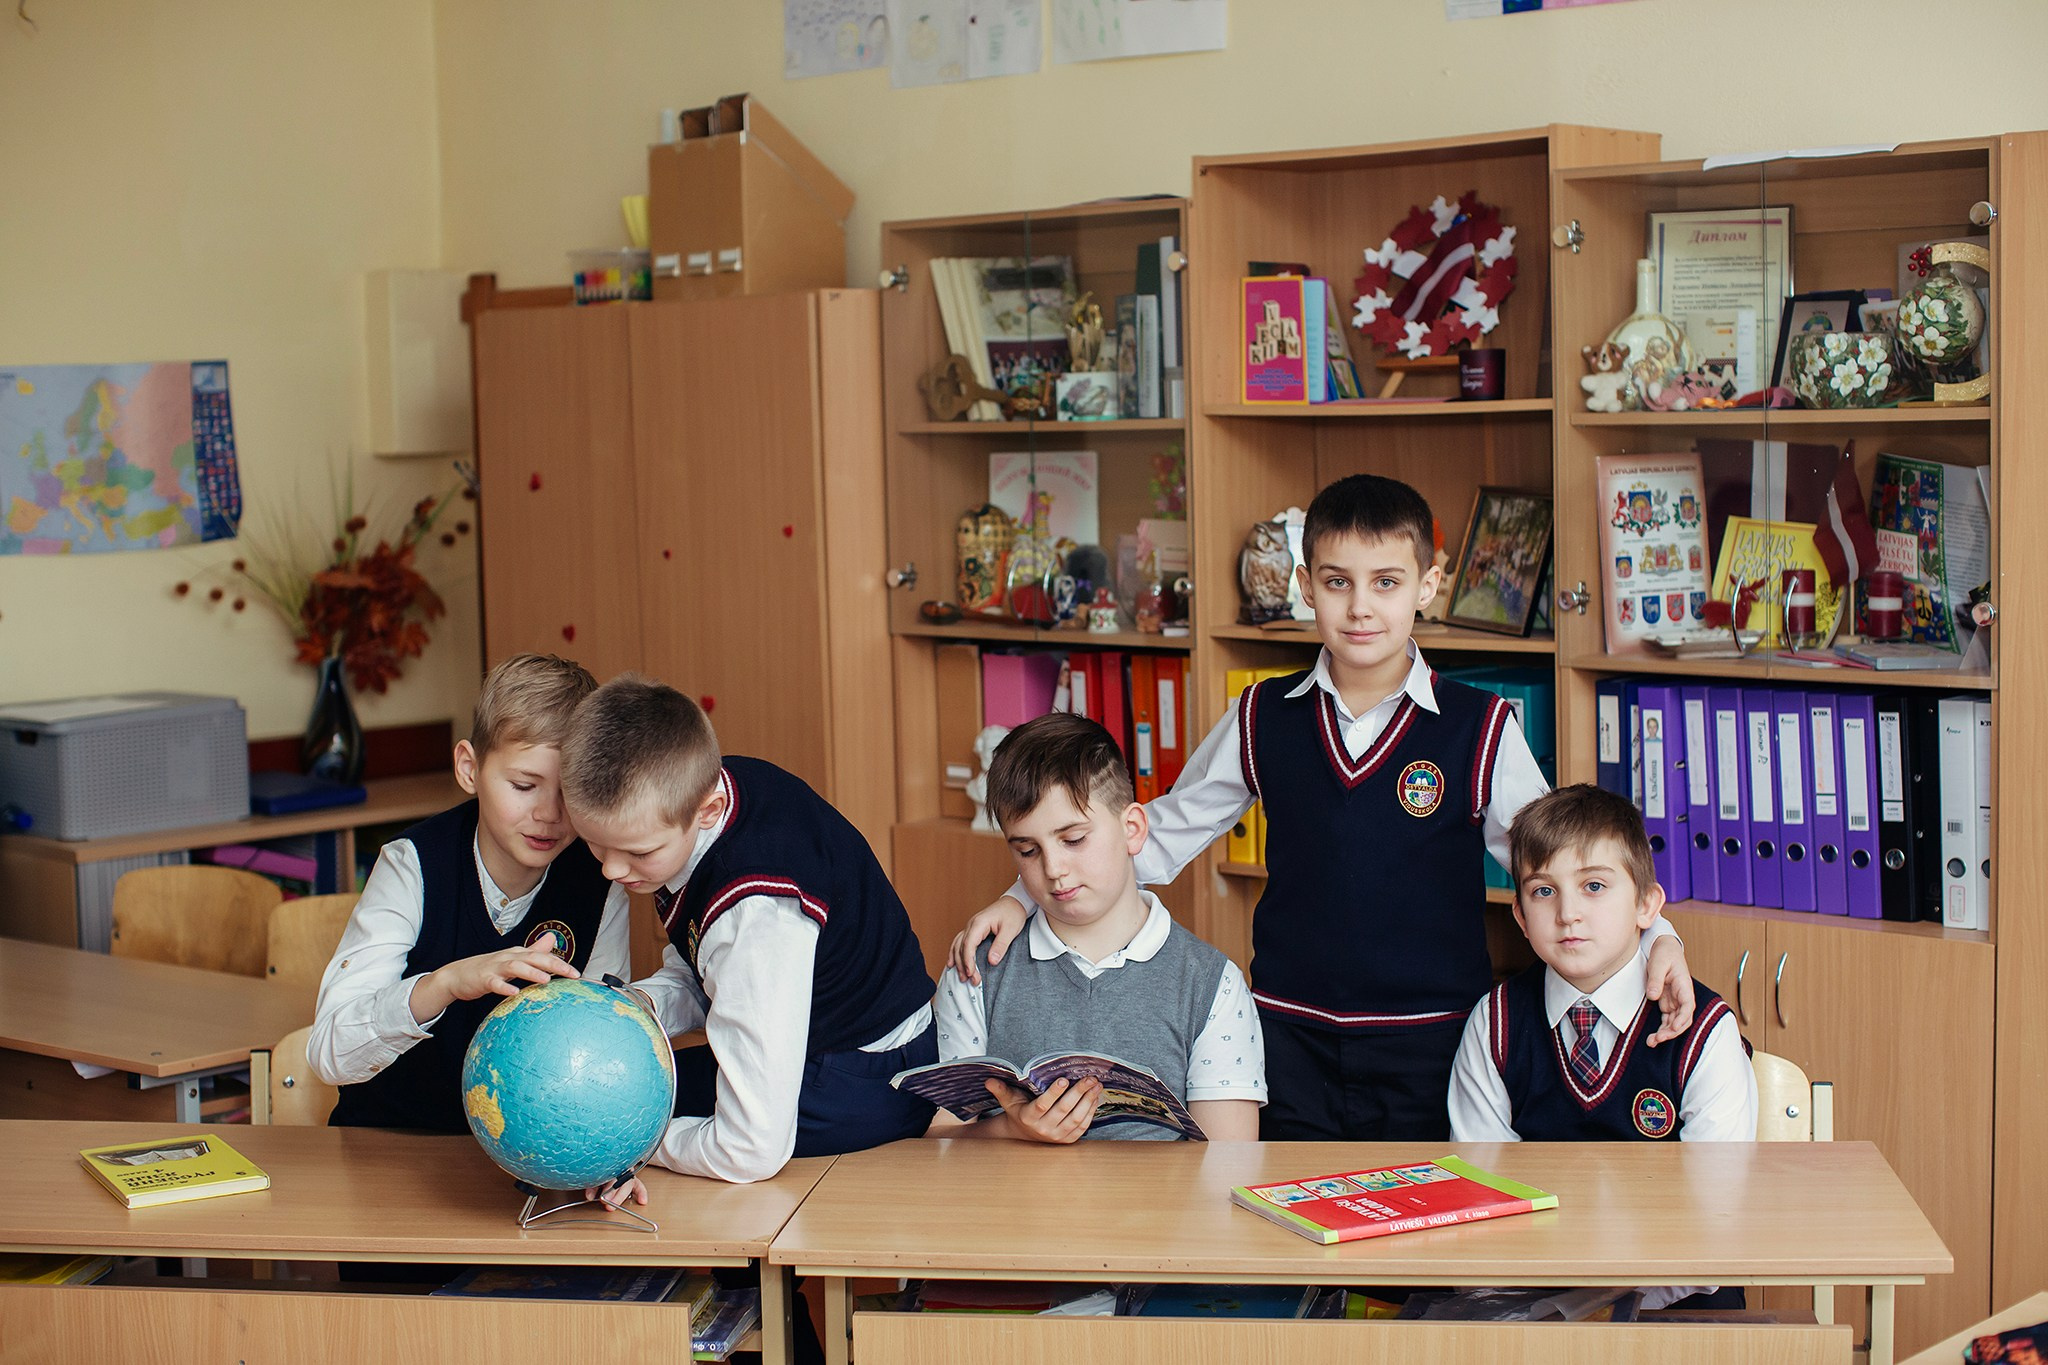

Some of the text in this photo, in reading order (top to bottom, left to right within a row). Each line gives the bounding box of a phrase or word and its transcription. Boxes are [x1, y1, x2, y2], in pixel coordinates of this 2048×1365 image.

[1687, 229, 1748, 245] Диплом
[1736, 531, 1796, 560] LATVIJAS
[1878, 531, 1914, 548] LATVIJAS
[1405, 784, 1437, 792] OSTVALDA
[1402, 799, 1437, 814] VIDUSSKOLA
[122, 1171, 177, 1183] ЯЗЫК
[127, 1171, 216, 1188] РУССКИЙ
[1389, 1216, 1426, 1232] LATVIEŠU
[1428, 1213, 1459, 1226] VALODA
